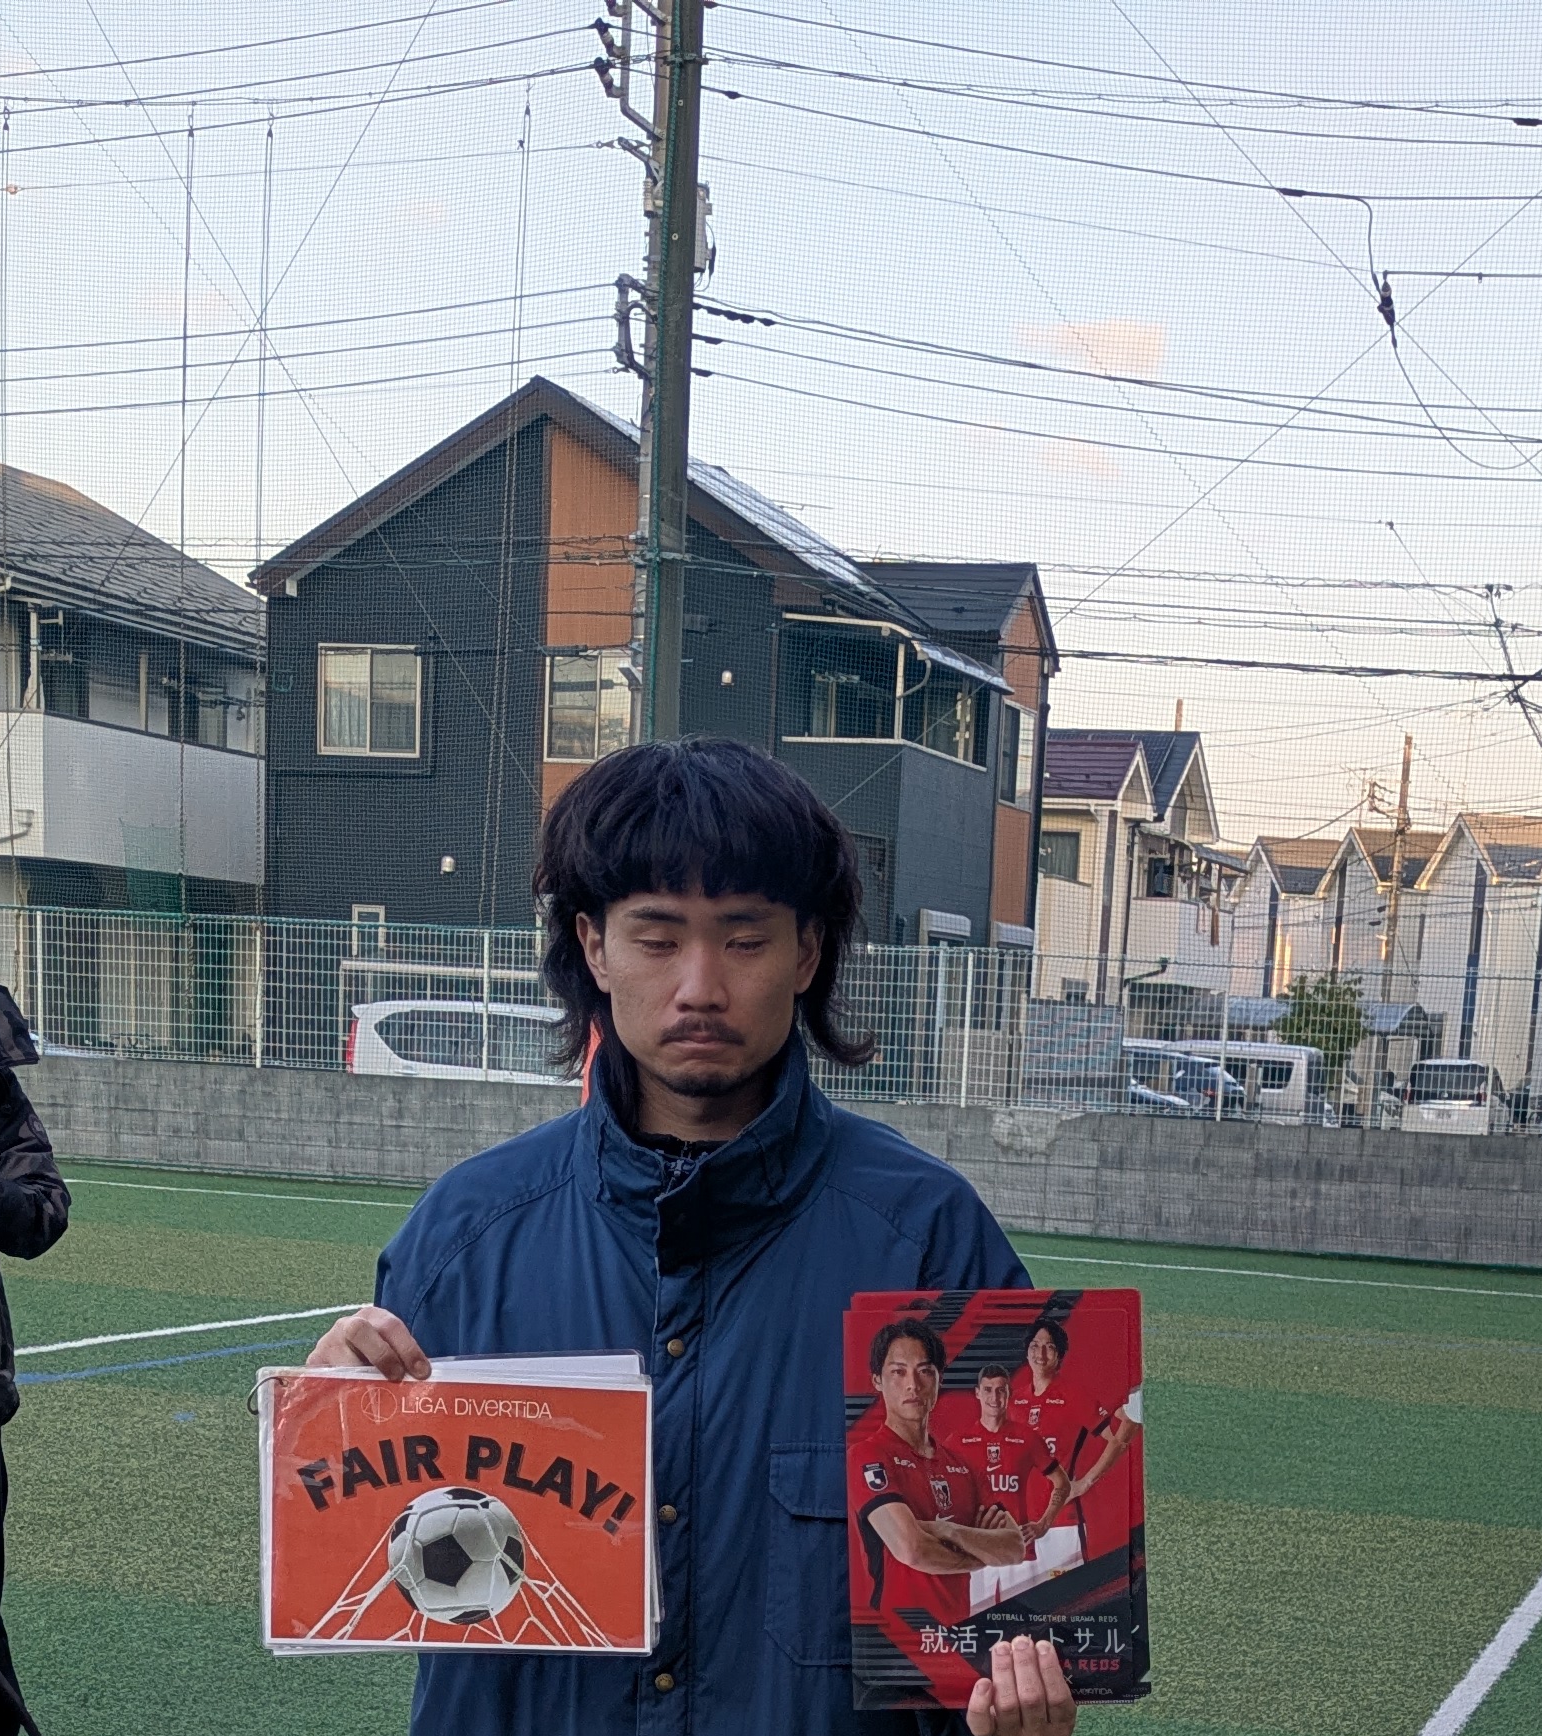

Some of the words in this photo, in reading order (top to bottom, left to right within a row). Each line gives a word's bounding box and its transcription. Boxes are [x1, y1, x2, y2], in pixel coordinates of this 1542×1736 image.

[297, 1434, 445, 1513] FAIR
[464, 1434, 637, 1536] PLAY!
[987, 1474, 1020, 1493] LUS
[986, 1613, 1024, 1622] FOOTBALL
[1070, 1615, 1096, 1623] URAWA
[1098, 1615, 1119, 1623] REDS
[919, 1624, 1126, 1654] 就活フトサル
[1078, 1658, 1120, 1672] REDS
